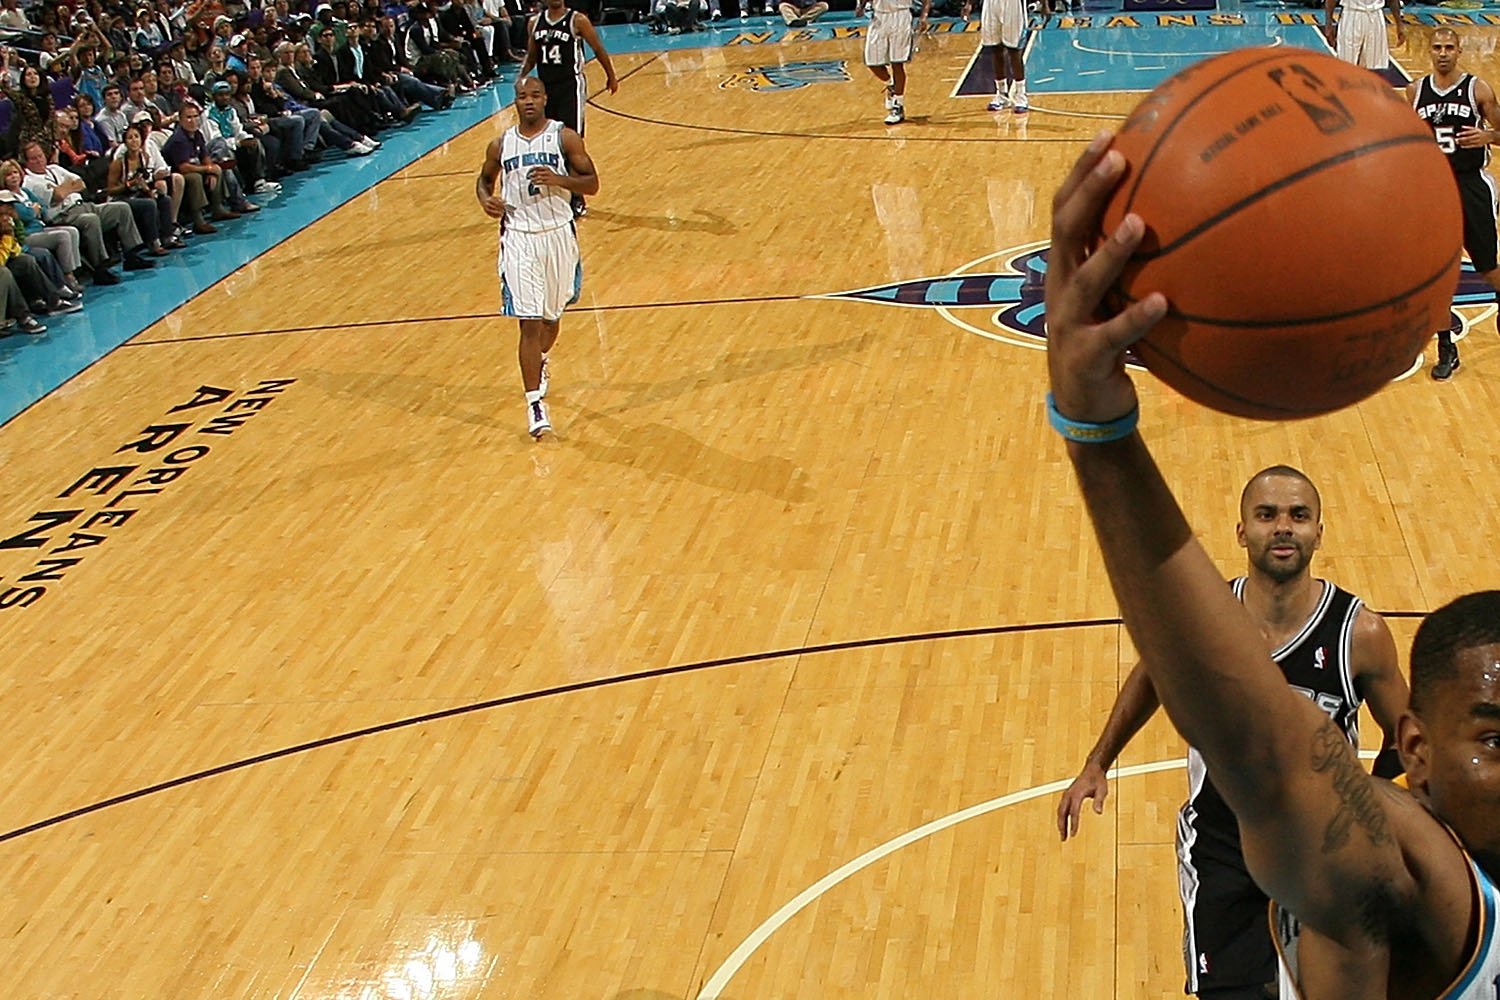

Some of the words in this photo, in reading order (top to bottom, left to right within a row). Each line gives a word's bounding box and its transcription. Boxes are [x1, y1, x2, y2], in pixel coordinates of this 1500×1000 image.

[541, 45, 562, 64] 14
[1417, 103, 1472, 121] SPURS
[197, 378, 299, 435] NEW
[0, 445, 211, 610] ORLEANS
